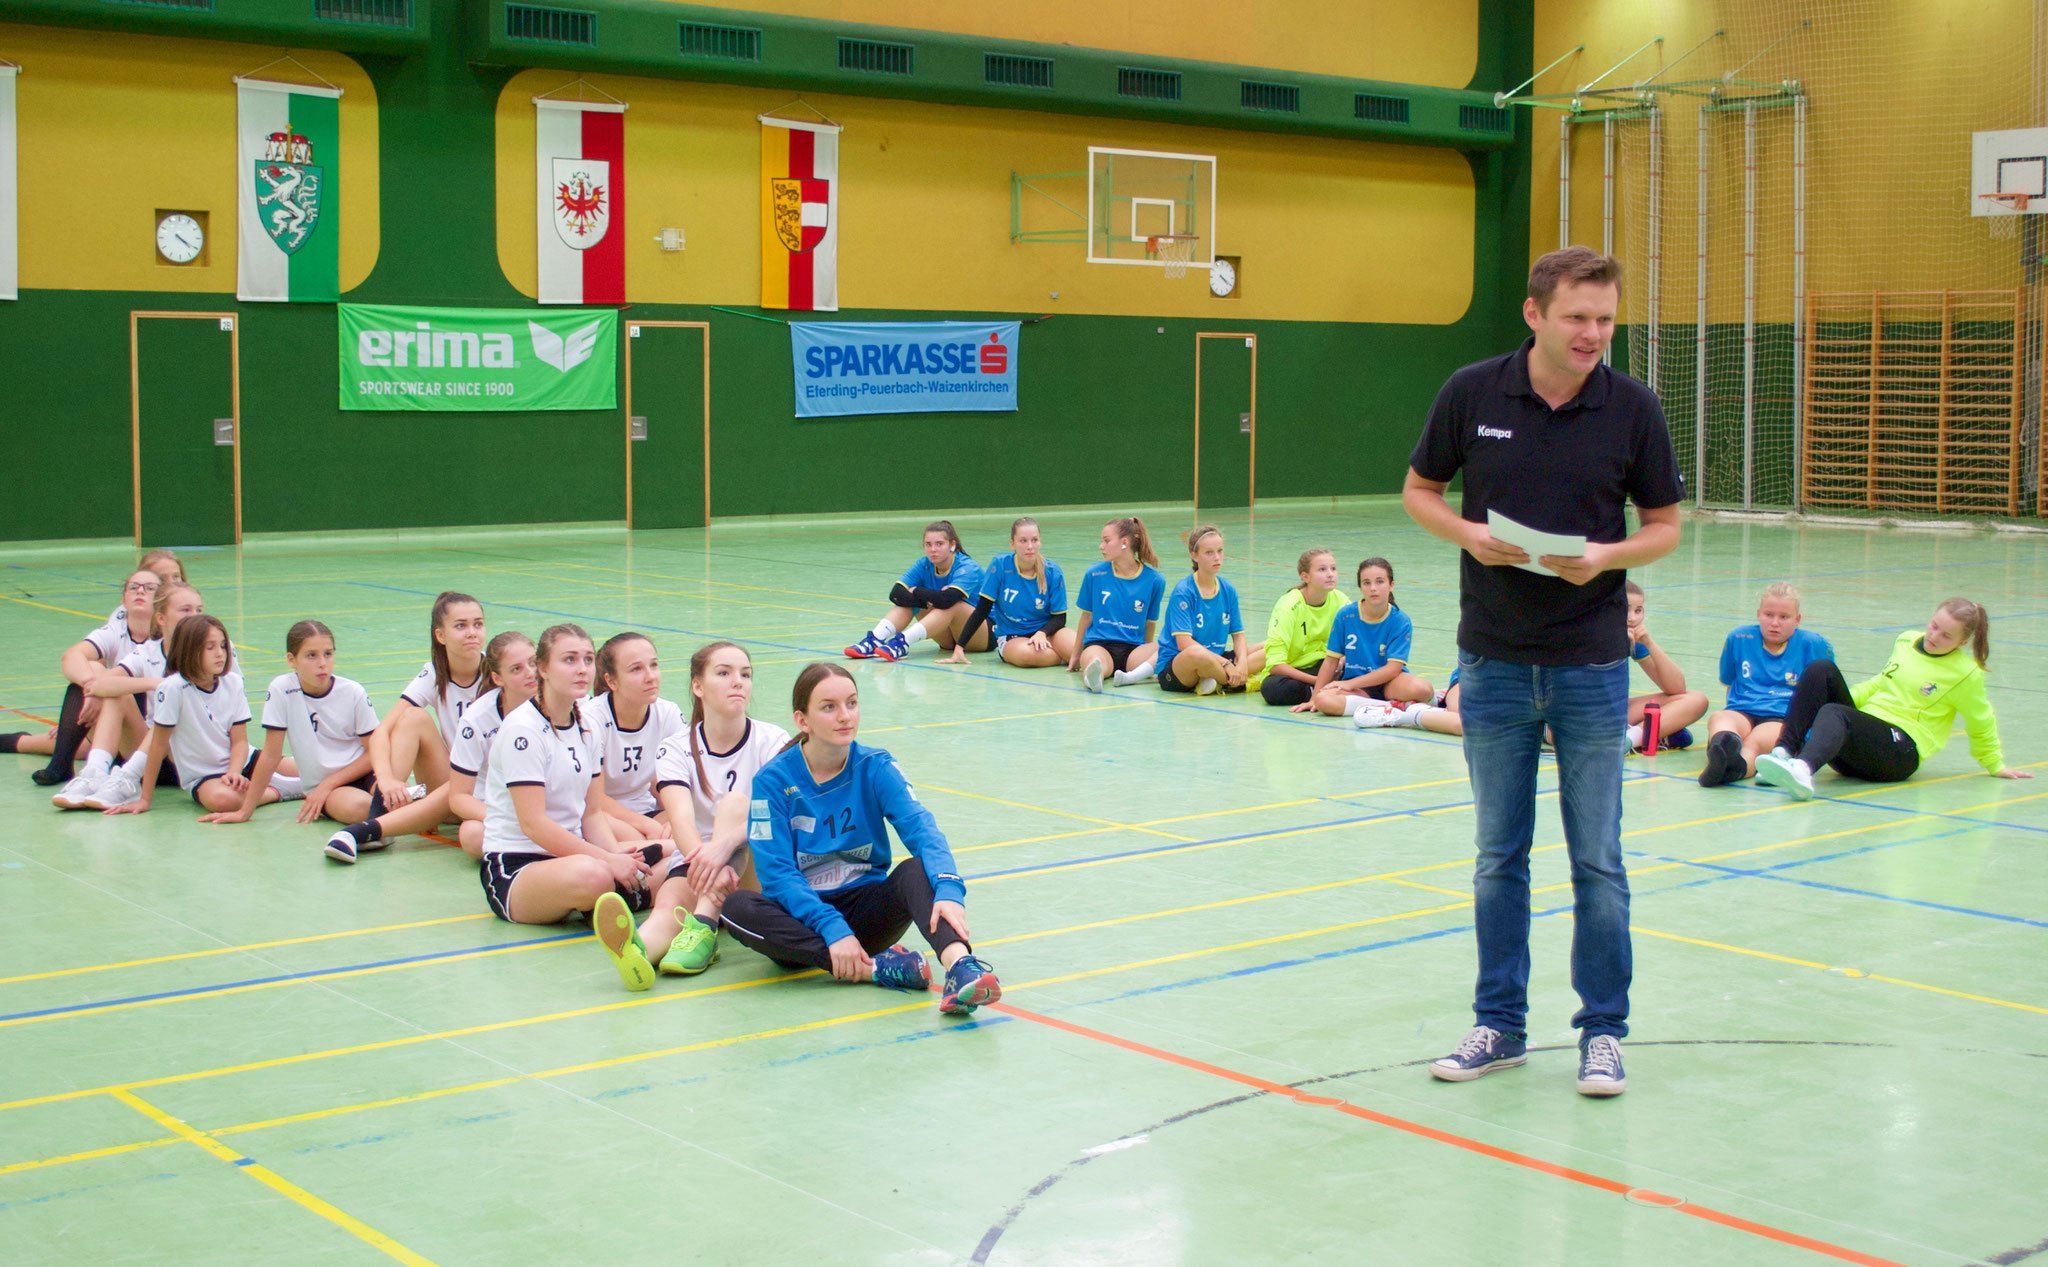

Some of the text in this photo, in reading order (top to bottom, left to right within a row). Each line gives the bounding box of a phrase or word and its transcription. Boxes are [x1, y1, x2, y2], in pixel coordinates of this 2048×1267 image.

[358, 322, 514, 369] erima
[805, 342, 976, 379] SPARKASSE
[359, 381, 514, 396] SPORTSWEAR SINCE 1900
[806, 380, 1009, 399] Eferding-Peuerbach-Waizenkirchen
[1477, 424, 1512, 440] Kempa
[1003, 587, 1019, 603] 17
[1101, 590, 1111, 605] 7
[1196, 613, 1204, 628] 3
[1300, 621, 1307, 636] 1
[1345, 633, 1358, 650] 2
[1741, 660, 1751, 679] 6
[567, 746, 582, 774] 3
[622, 745, 643, 773] 53
[823, 806, 857, 839] 12
